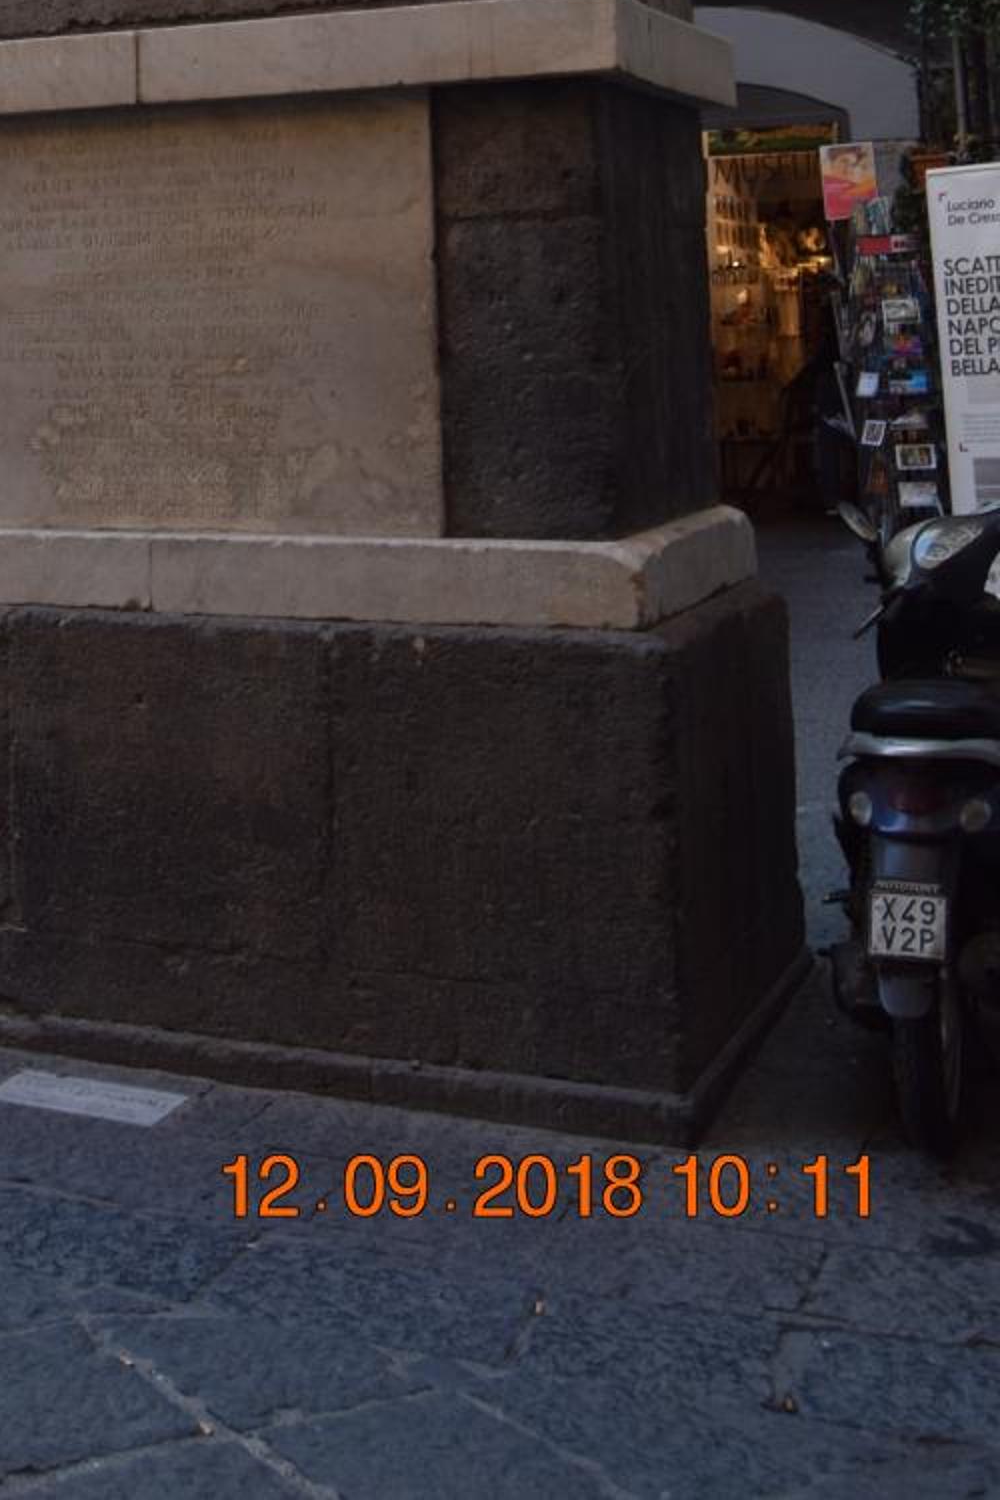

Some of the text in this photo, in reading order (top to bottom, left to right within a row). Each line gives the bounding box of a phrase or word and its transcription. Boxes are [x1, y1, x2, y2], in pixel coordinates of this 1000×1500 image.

[947, 296, 1000, 316] DELLA
[949, 337, 984, 357] DEL
[951, 357, 1000, 377] BELLA
[881, 896, 936, 926] X49
[881, 925, 935, 953] V2P
